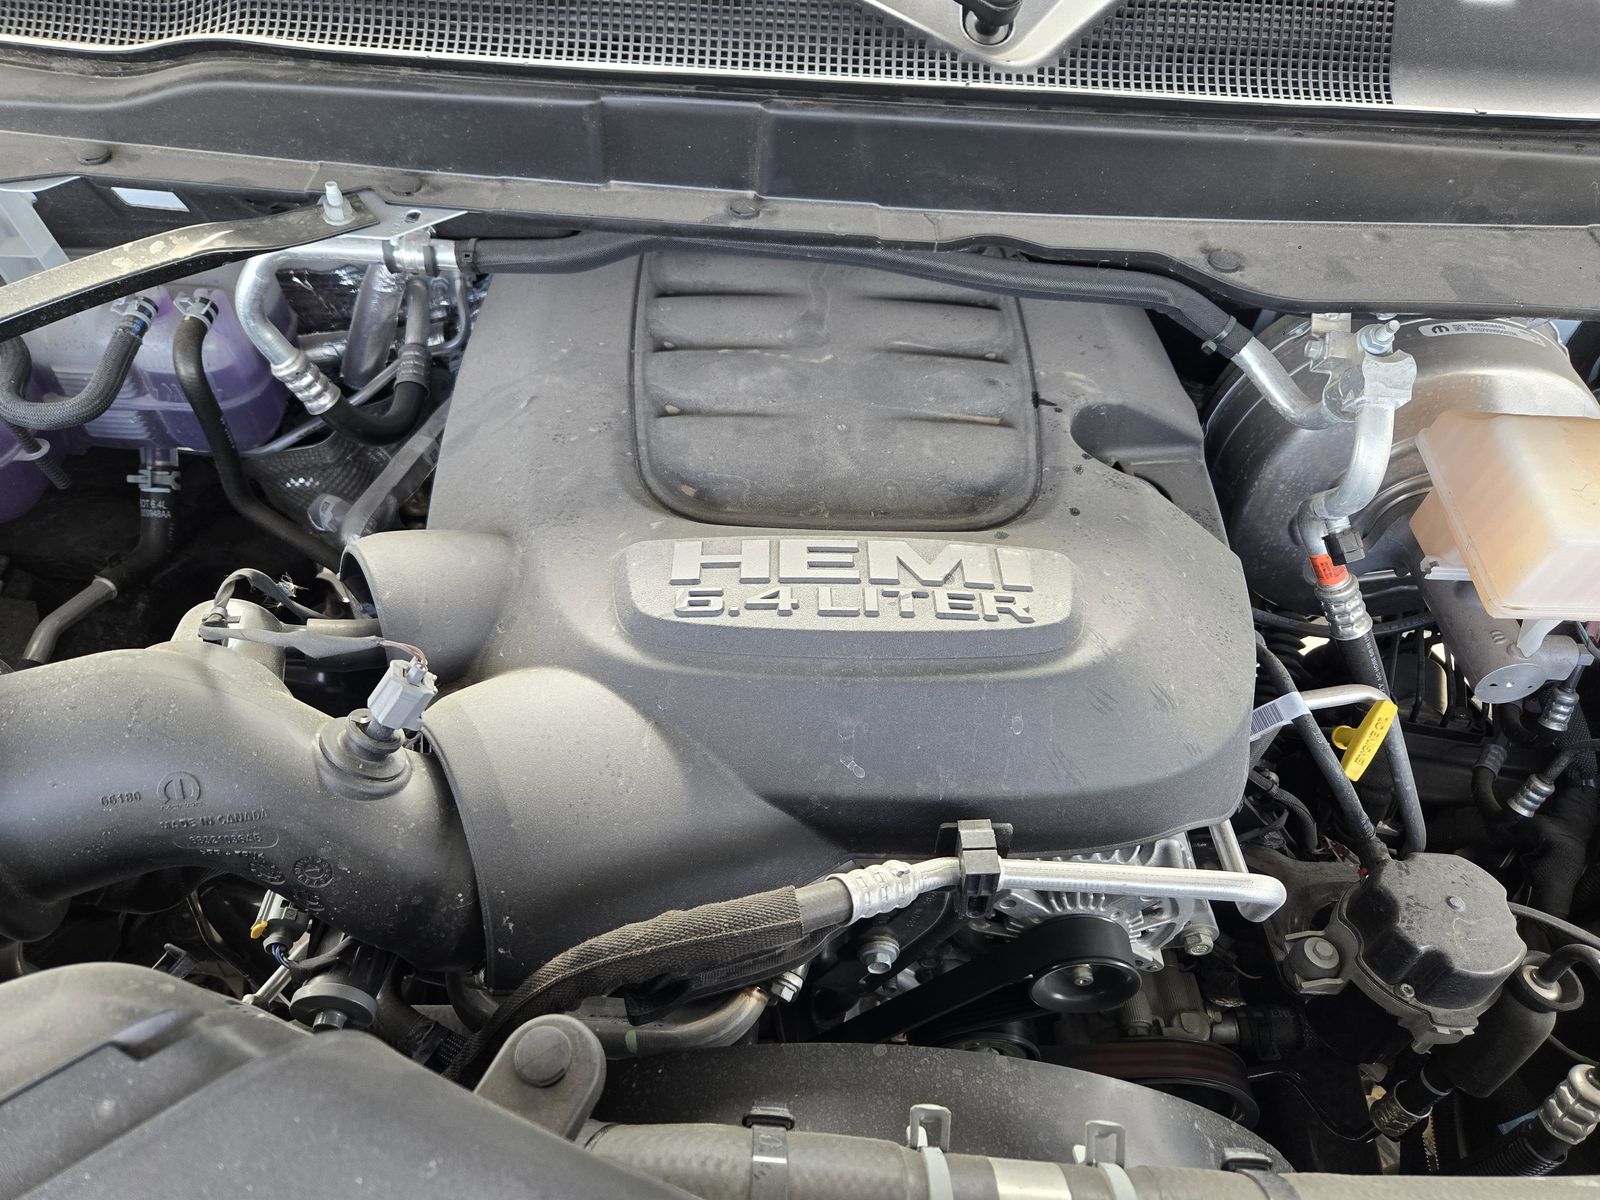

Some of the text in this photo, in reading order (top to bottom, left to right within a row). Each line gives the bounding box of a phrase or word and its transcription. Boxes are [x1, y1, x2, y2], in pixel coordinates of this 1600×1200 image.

[669, 540, 1035, 592] HEMI
[673, 586, 1036, 624] 6.4 LITER
[1354, 729, 1381, 766] ENGINE
[159, 807, 269, 831] MADE IN CANADA
